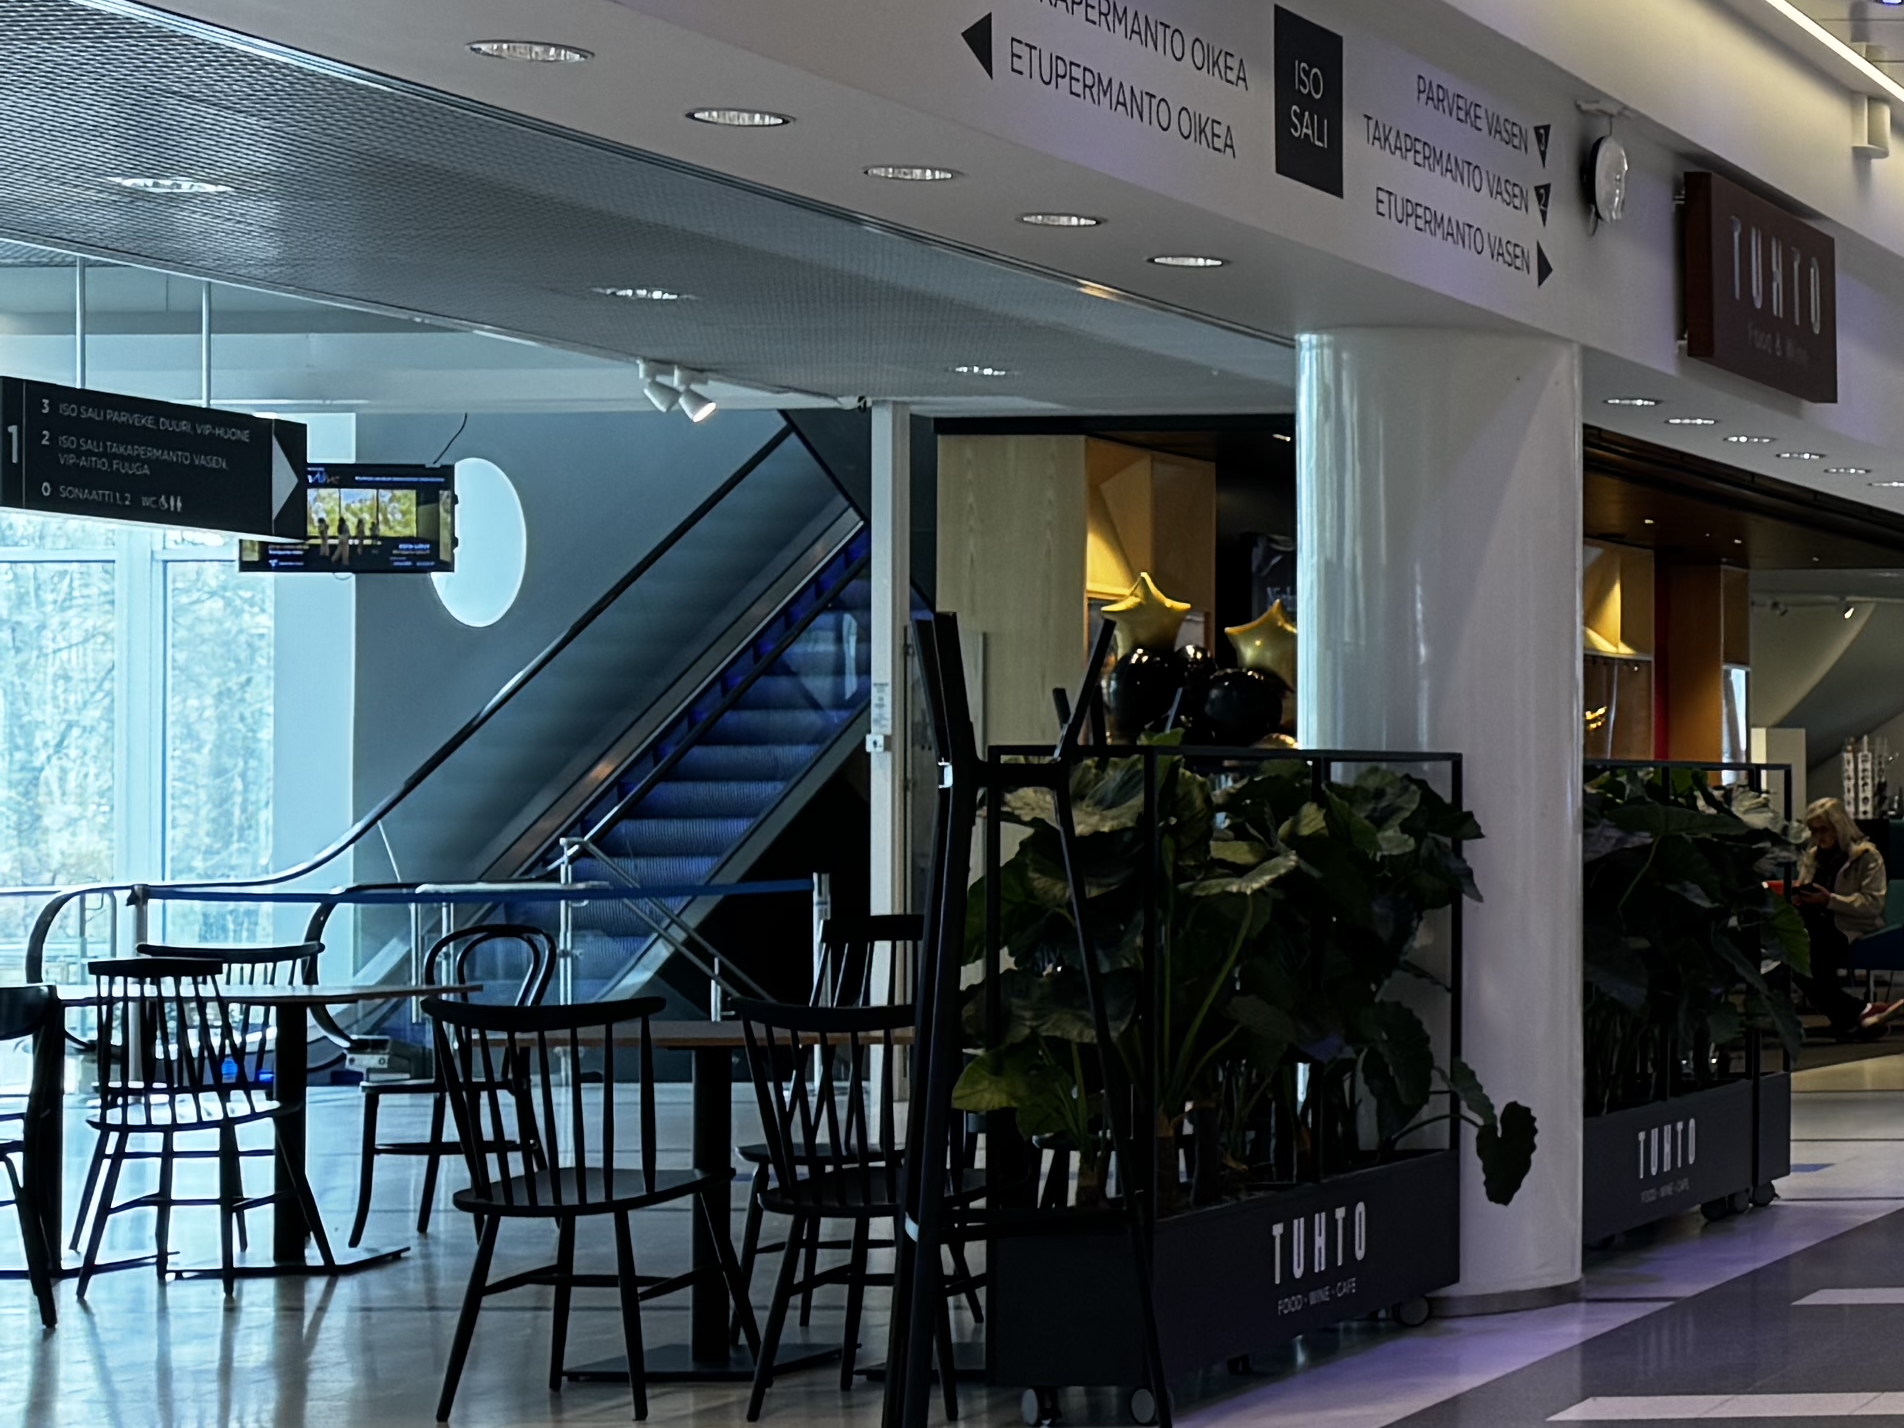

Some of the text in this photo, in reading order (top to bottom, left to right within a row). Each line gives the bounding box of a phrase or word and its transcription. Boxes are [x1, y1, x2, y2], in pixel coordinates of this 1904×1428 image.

[1191, 37, 1248, 91] OIKEA
[1294, 59, 1323, 100] ISO
[1010, 36, 1236, 159] ETUPERMANTO OIKEA
[1417, 74, 1482, 132] PARVEKE
[1485, 108, 1528, 155] VASEN
[1290, 105, 1328, 149] SALI
[1363, 114, 1483, 193] TAKAPERMANTO
[1486, 170, 1529, 214] VASEN
[1376, 186, 1530, 275] ETUPERMANTO VASEN
[1731, 215, 1821, 335] TUHTO
[8, 425, 18, 464] 1
[41, 399, 50, 414] 3
[59, 403, 78, 417] ISO
[80, 405, 104, 421] SALI
[196, 424, 250, 442] VIP-HUONE
[41, 431, 50, 445] 2
[59, 435, 76, 450] ISO
[79, 438, 103, 453] SALI
[106, 441, 191, 465] TAKAPERMANTO
[112, 460, 150, 476] FUUGA
[41, 482, 51, 497] 0
[59, 486, 114, 504] SONAATTI
[1638, 1118, 1695, 1179] TUHTO
[1272, 1201, 1365, 1284] TUHTO
